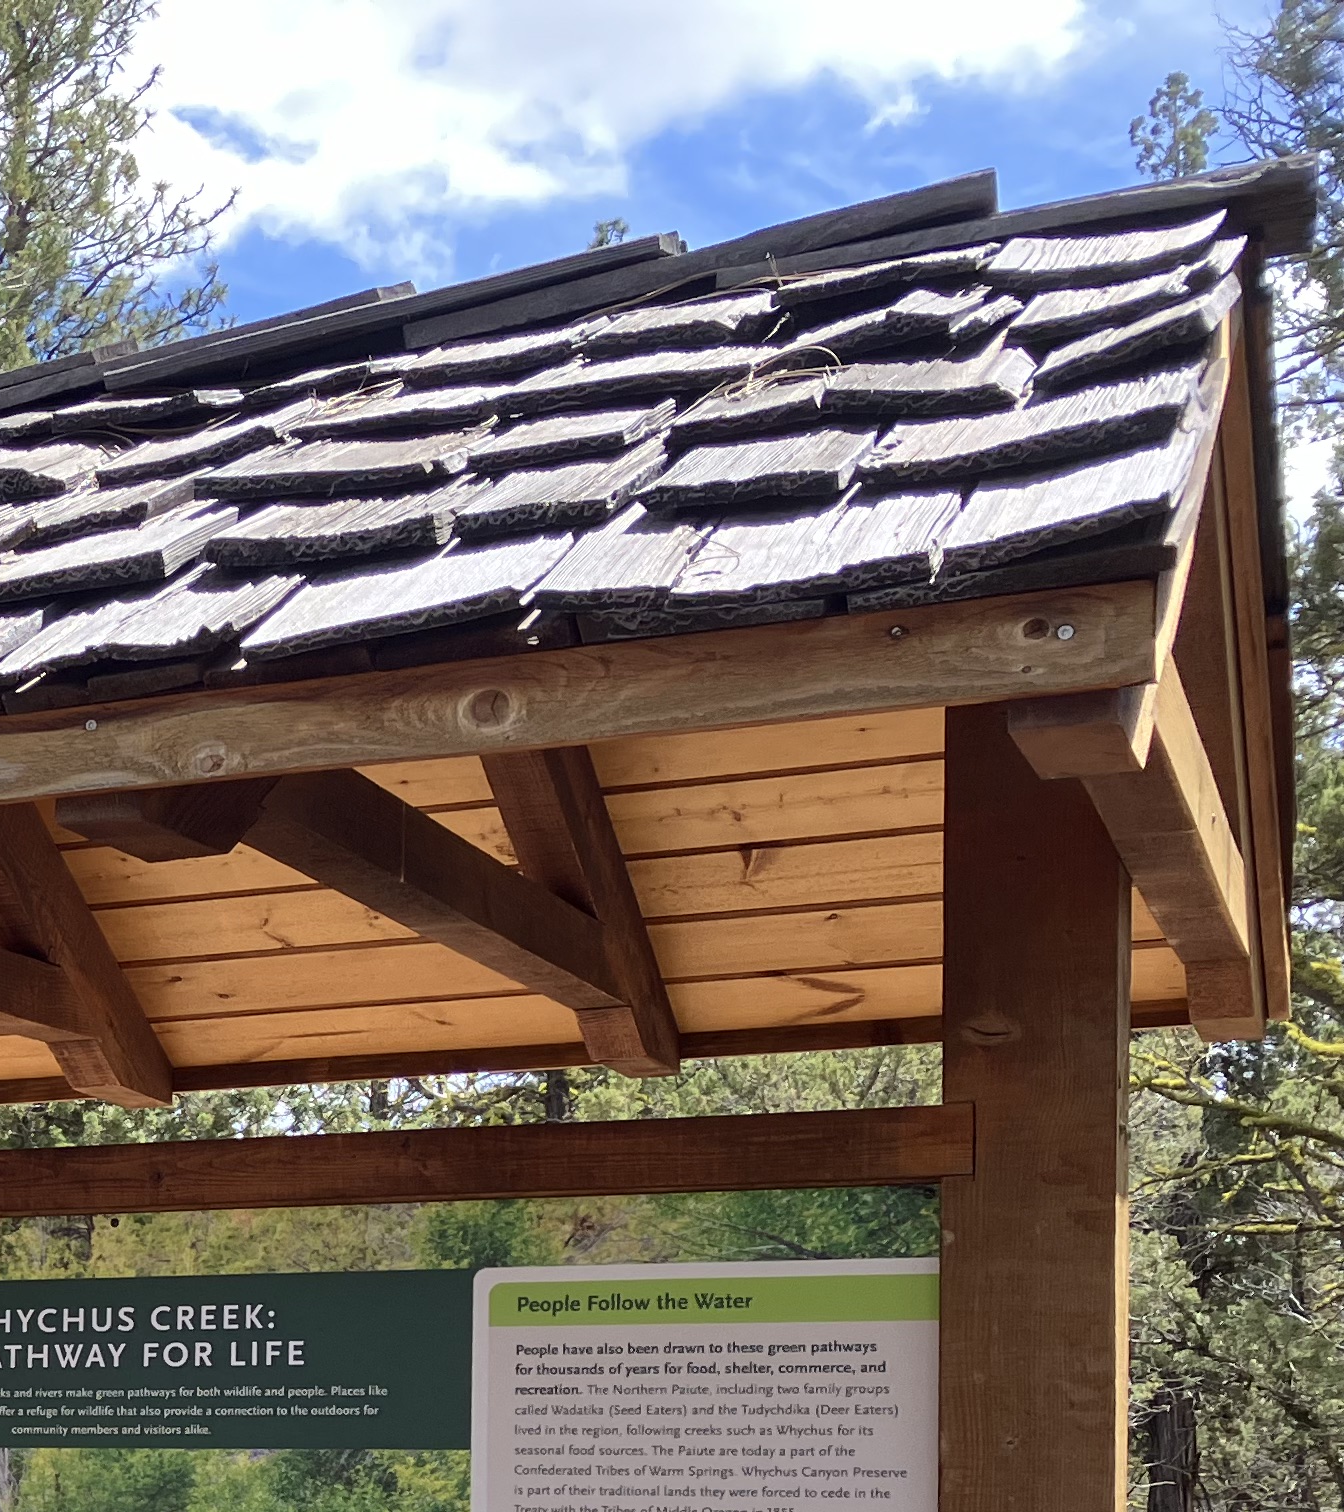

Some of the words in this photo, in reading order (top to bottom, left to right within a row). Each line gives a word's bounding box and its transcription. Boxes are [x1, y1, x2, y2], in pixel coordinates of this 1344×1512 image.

[517, 1293, 581, 1317] People
[587, 1293, 651, 1312] Follow
[656, 1291, 689, 1311] the
[693, 1292, 753, 1310] Water
[150, 1303, 275, 1331] CREEK:
[143, 1341, 213, 1367] FOR
[230, 1340, 305, 1367] LIFE
[515, 1344, 559, 1358] People
[562, 1343, 593, 1354] have
[596, 1343, 624, 1354] also
[627, 1342, 659, 1354] been
[663, 1342, 705, 1354] drawn
[708, 1344, 723, 1353] to
[726, 1342, 764, 1353] these
[767, 1344, 807, 1356] green
[811, 1339, 878, 1357] pathways
[514, 1364, 534, 1375] for
[536, 1363, 605, 1375] thousands
[608, 1362, 625, 1374] of
[624, 1366, 661, 1378] years
[664, 1362, 683, 1374] for
[686, 1362, 721, 1375] food,
[724, 1362, 775, 1376] shelter,
[777, 1365, 856, 1375] commerce,
[860, 1361, 887, 1373] and
[11, 1426, 69, 1436] community
[70, 1424, 119, 1434] members
[121, 1424, 141, 1434] and
[143, 1425, 182, 1434] visitors
[184, 1424, 212, 1434] alike.
